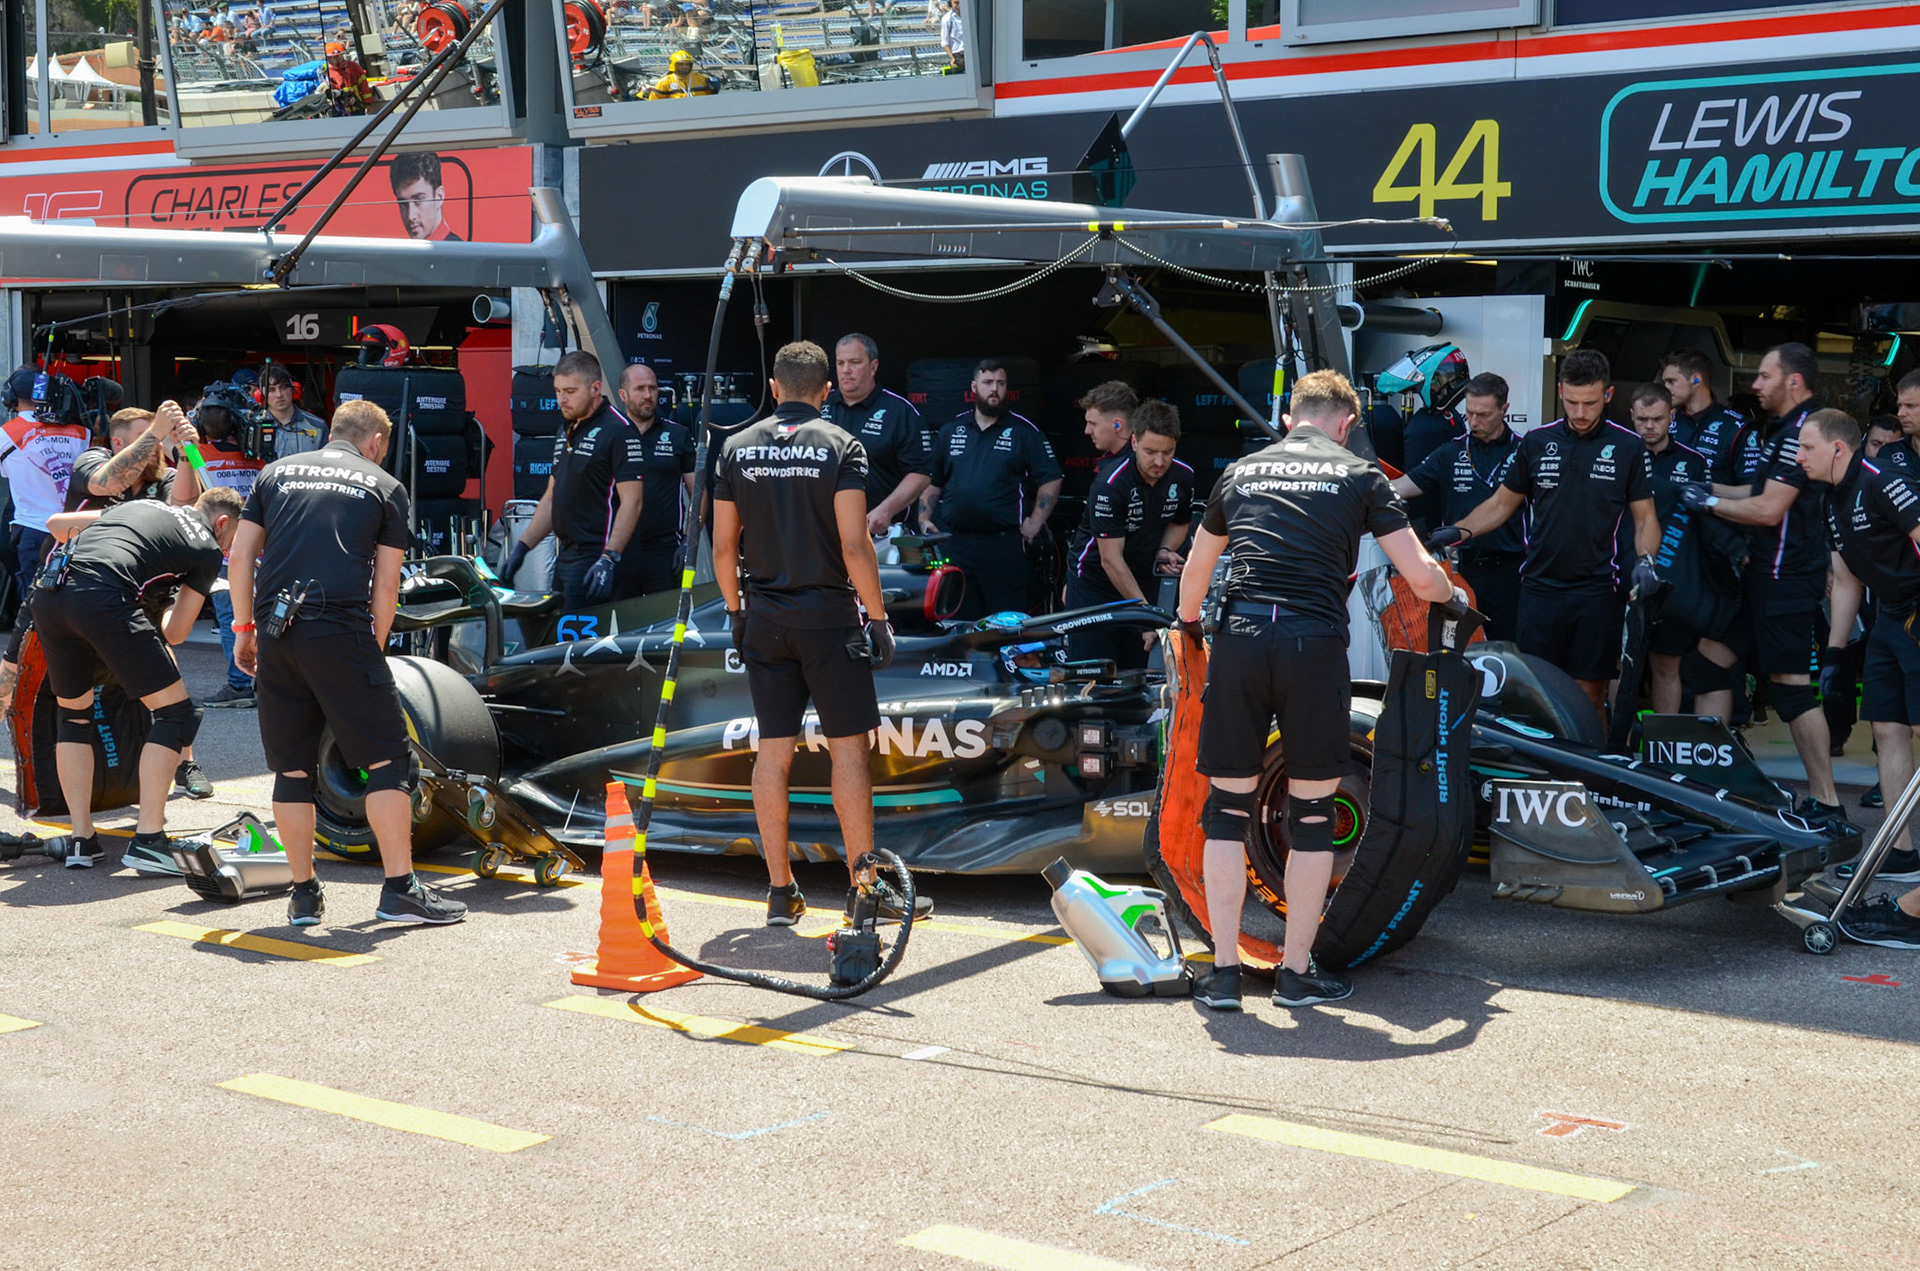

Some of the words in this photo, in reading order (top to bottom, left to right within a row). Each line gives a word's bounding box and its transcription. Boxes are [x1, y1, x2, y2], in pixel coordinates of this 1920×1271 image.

[1648, 91, 1862, 152] LEWIS
[961, 157, 1048, 178] AMG
[1372, 119, 1512, 221] 44
[151, 182, 302, 223] CHARLES
[1572, 260, 1594, 277] IWC
[286, 313, 320, 340] 16
[1196, 394, 1218, 406] LEFT
[735, 445, 829, 462] PETRONAS
[217, 470, 257, 478] 0084-MON
[274, 464, 378, 487] PETRONAS
[530, 463, 553, 475] RIGHT
[746, 466, 820, 478] CROWDSTRIKE
[1234, 461, 1349, 480] PETRONAS
[1592, 465, 1616, 474] INEOS
[281, 480, 366, 499] CROWDSTRIKE
[1241, 480, 1340, 495] CROWDSTRIKE
[1656, 524, 1684, 568] REAR
[557, 614, 600, 644] 63
[1056, 612, 1113, 631] CROWDSTRIKE
[920, 663, 958, 677] AMD
[97, 724, 119, 768] RIGHT
[1648, 741, 1733, 767] INEOS
[1436, 749, 1449, 804] RIGHT
[1496, 787, 1587, 827] IWC
[1387, 879, 1424, 930] FRONT
